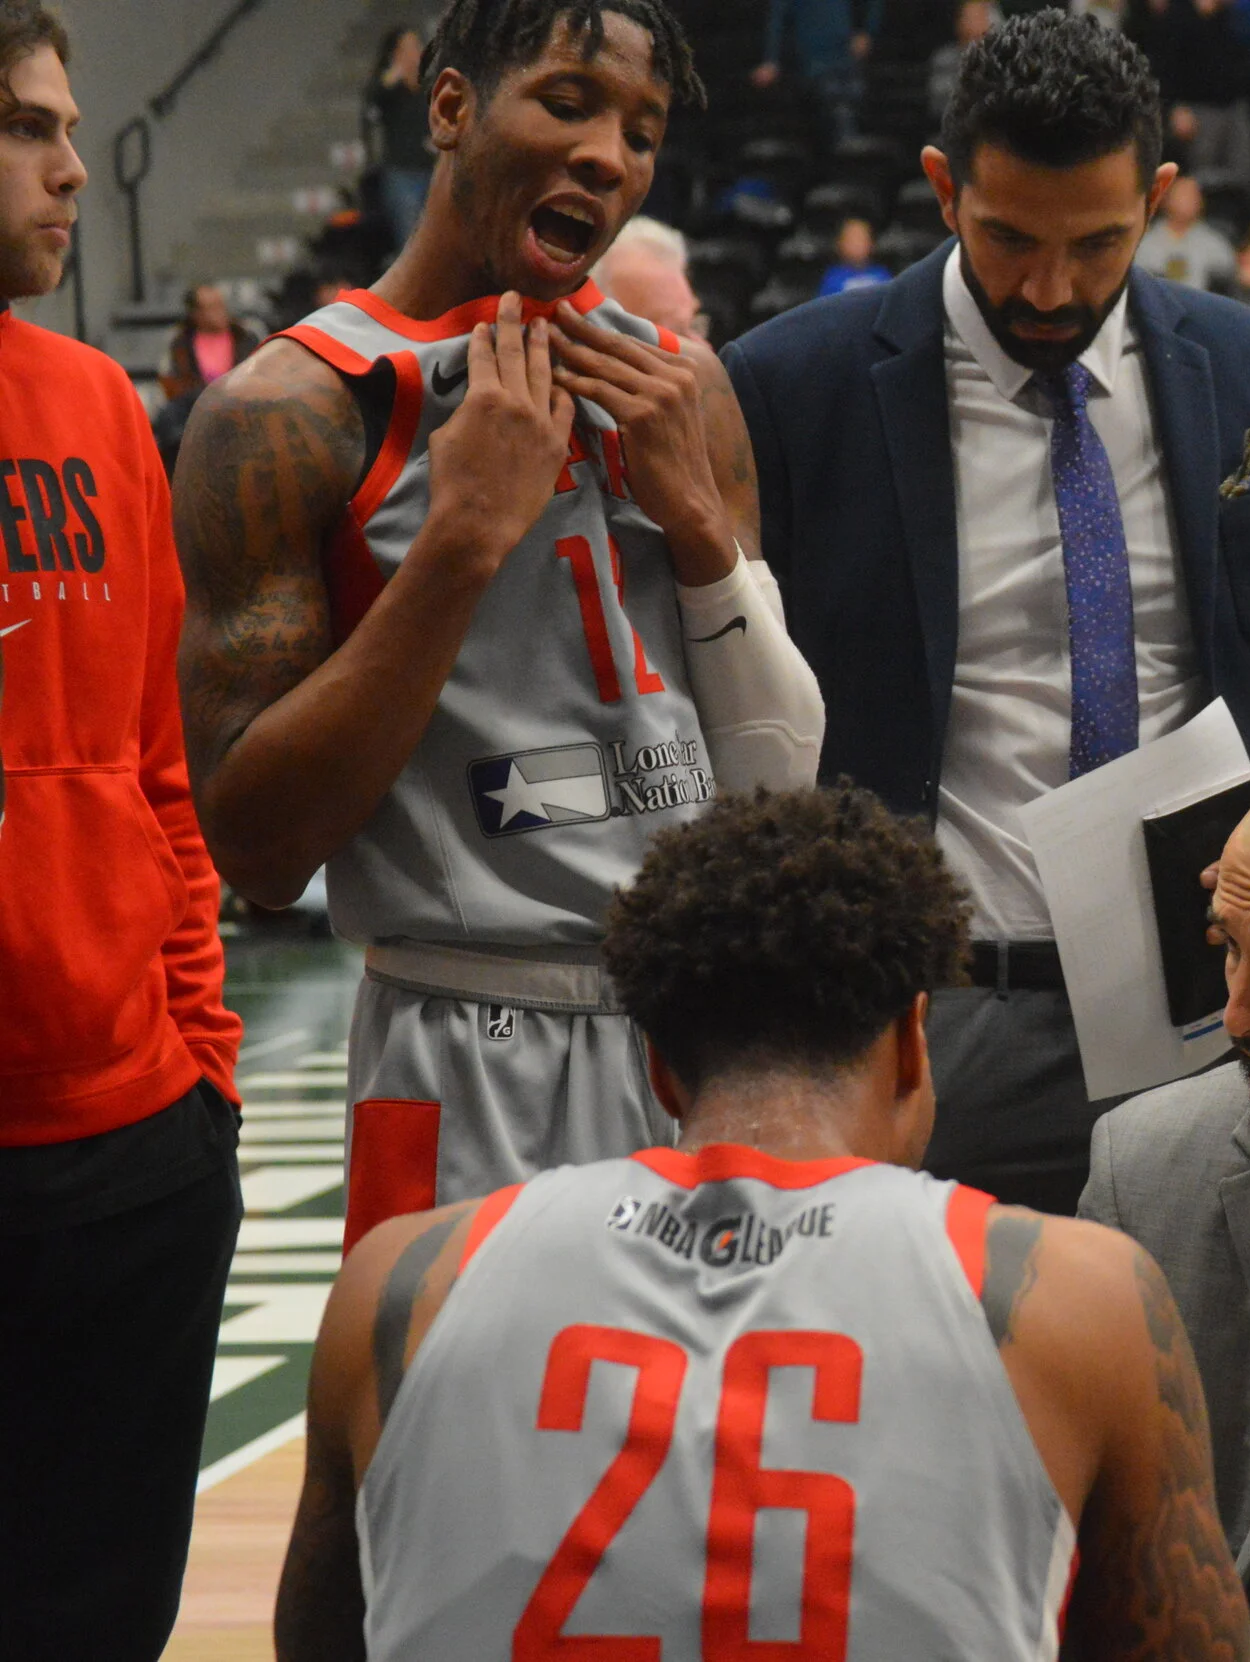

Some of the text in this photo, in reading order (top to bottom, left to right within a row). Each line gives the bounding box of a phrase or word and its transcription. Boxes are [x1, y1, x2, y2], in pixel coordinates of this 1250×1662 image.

[608, 740, 679, 776] Lone
[636, 1203, 698, 1260] NBA
[511, 1322, 864, 1662] 26
